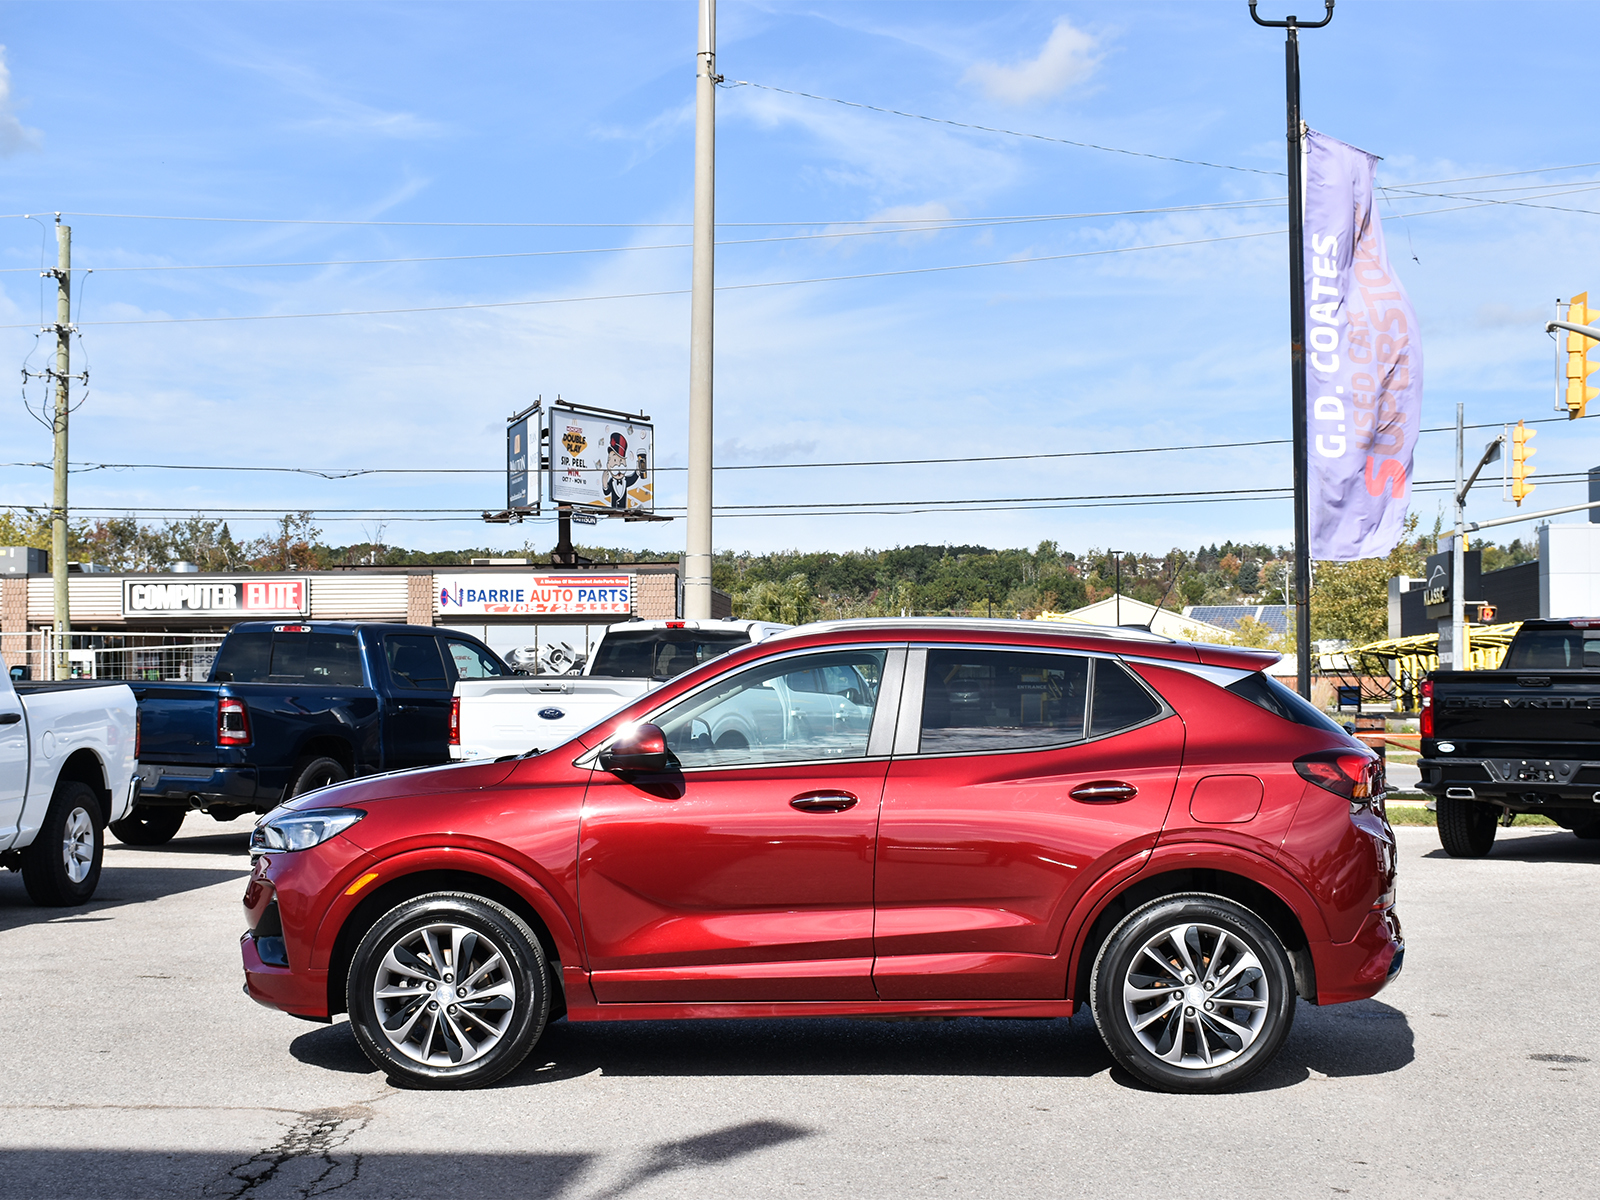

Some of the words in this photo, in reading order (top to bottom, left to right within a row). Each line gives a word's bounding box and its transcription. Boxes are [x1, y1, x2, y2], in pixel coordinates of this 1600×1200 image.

[1310, 233, 1340, 373] COATES
[1346, 310, 1373, 364] CAR
[1351, 372, 1377, 450] USED
[1314, 386, 1346, 458] G.D.
[563, 433, 586, 444] DOUBLE
[567, 444, 581, 453] PLAY
[561, 456, 571, 466] SIP.
[572, 458, 588, 468] PEEL.
[132, 584, 237, 610] COMPUTER
[248, 583, 298, 609] ELITE
[467, 589, 524, 602] BARRIE
[530, 588, 573, 602] AUTO
[578, 589, 628, 602] PARTS
[194, 654, 217, 664] EPS
[492, 725, 587, 738] F-15
